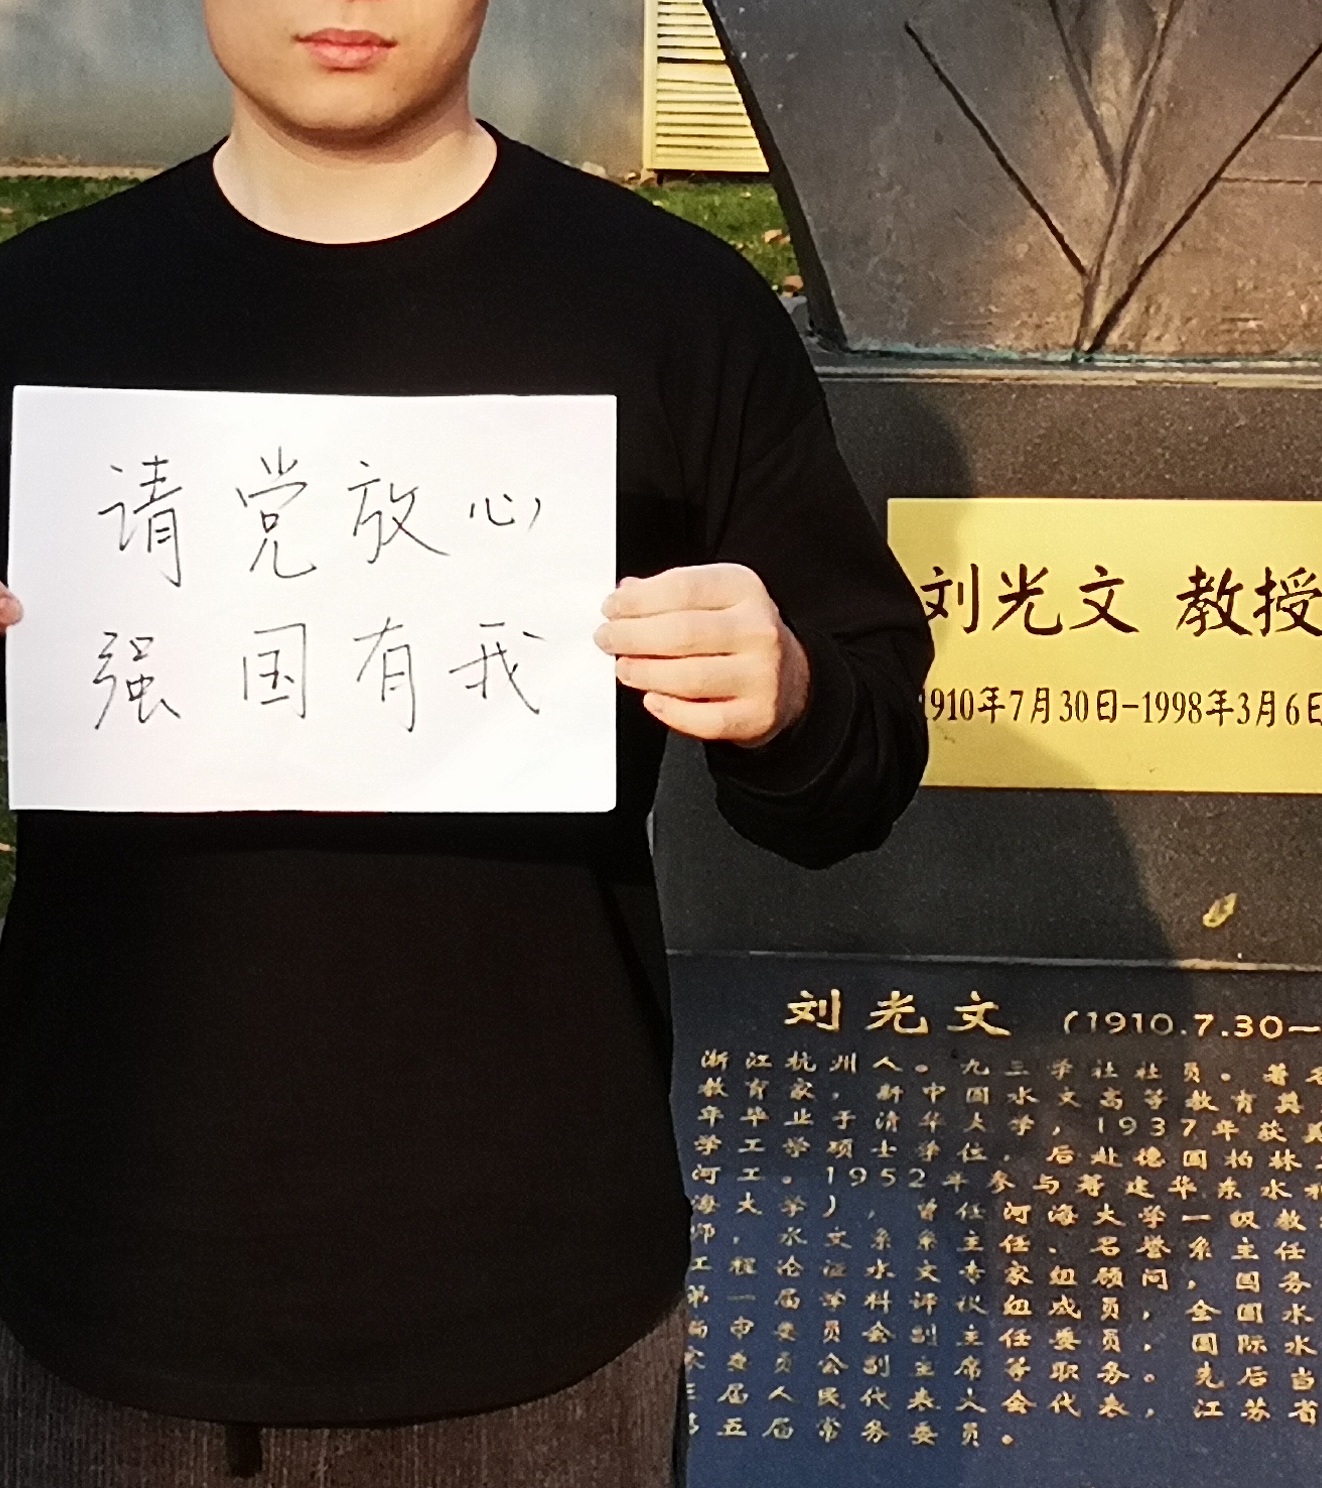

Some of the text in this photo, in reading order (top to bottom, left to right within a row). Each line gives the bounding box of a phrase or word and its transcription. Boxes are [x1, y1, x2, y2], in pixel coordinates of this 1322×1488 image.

[97, 446, 542, 588] 请党放心
[920, 563, 1140, 637] 刘光文
[93, 617, 547, 733] 强国有我
[784, 988, 1012, 1037] 刘光文
